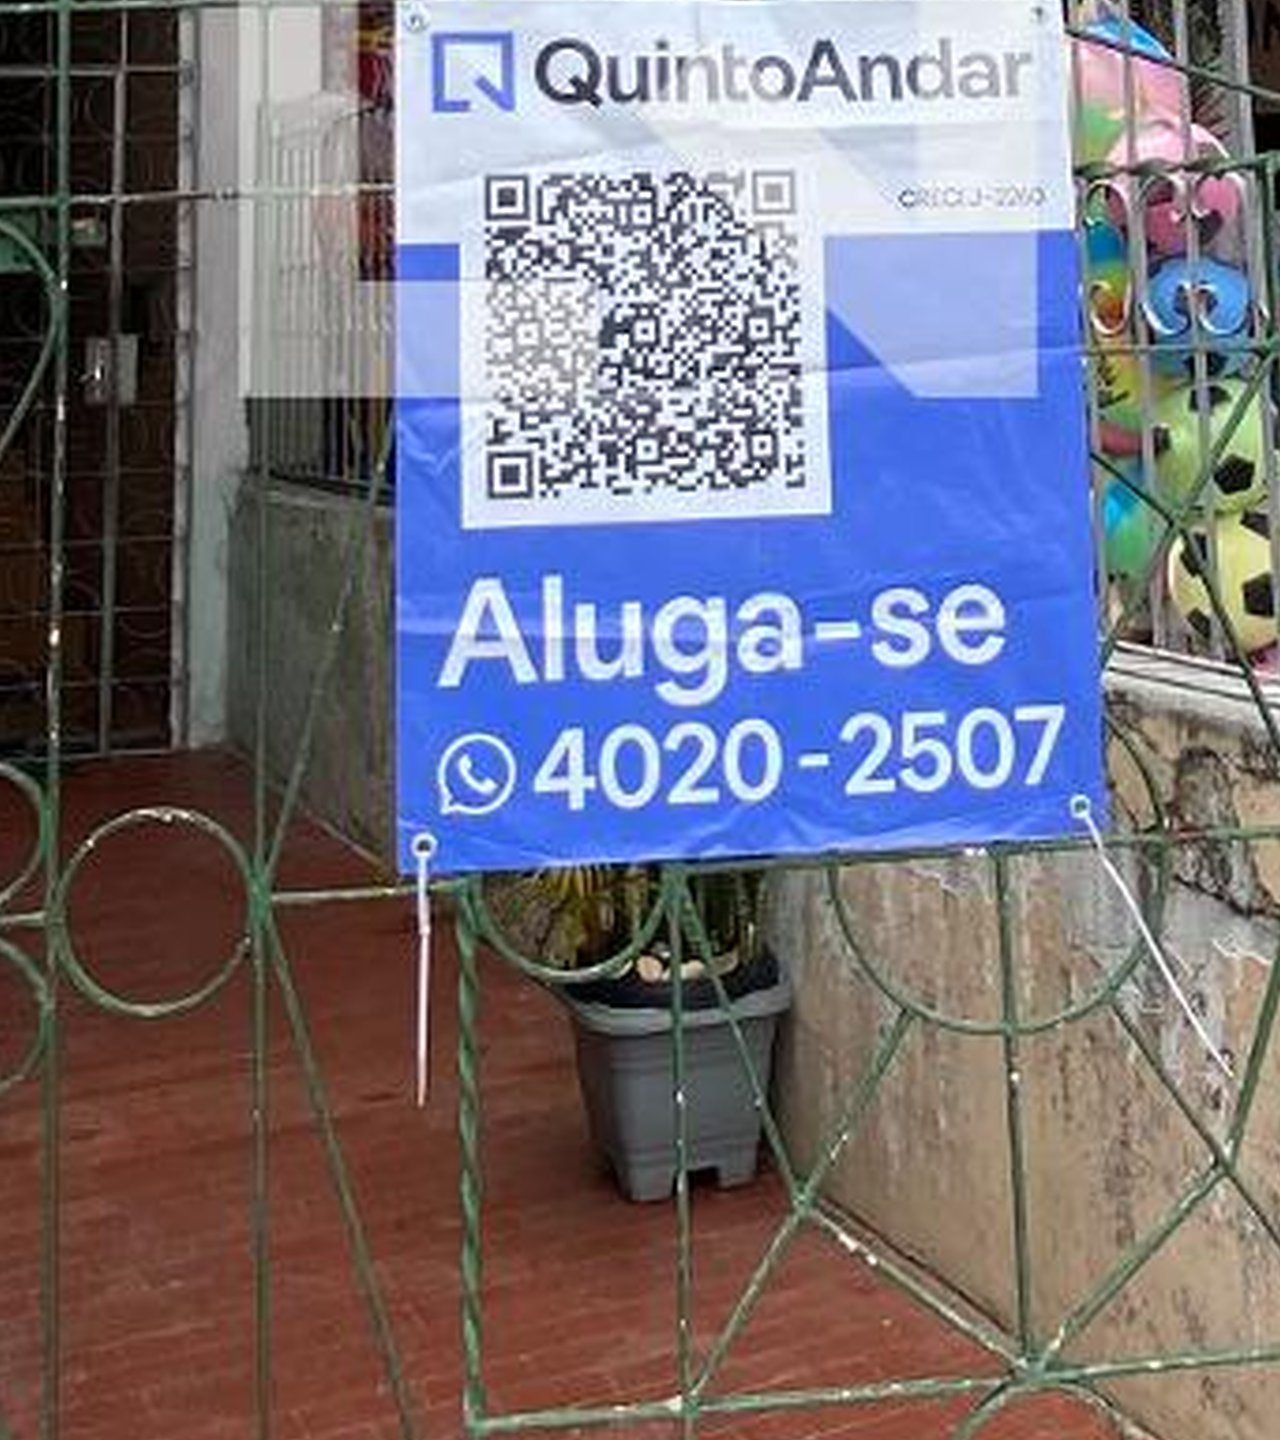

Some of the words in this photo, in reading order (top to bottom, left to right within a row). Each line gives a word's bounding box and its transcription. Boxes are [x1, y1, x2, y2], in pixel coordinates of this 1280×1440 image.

[533, 37, 1032, 107] QuintoAndar
[436, 574, 1007, 706] Aluga-se
[532, 704, 1066, 811] 4020-2507
